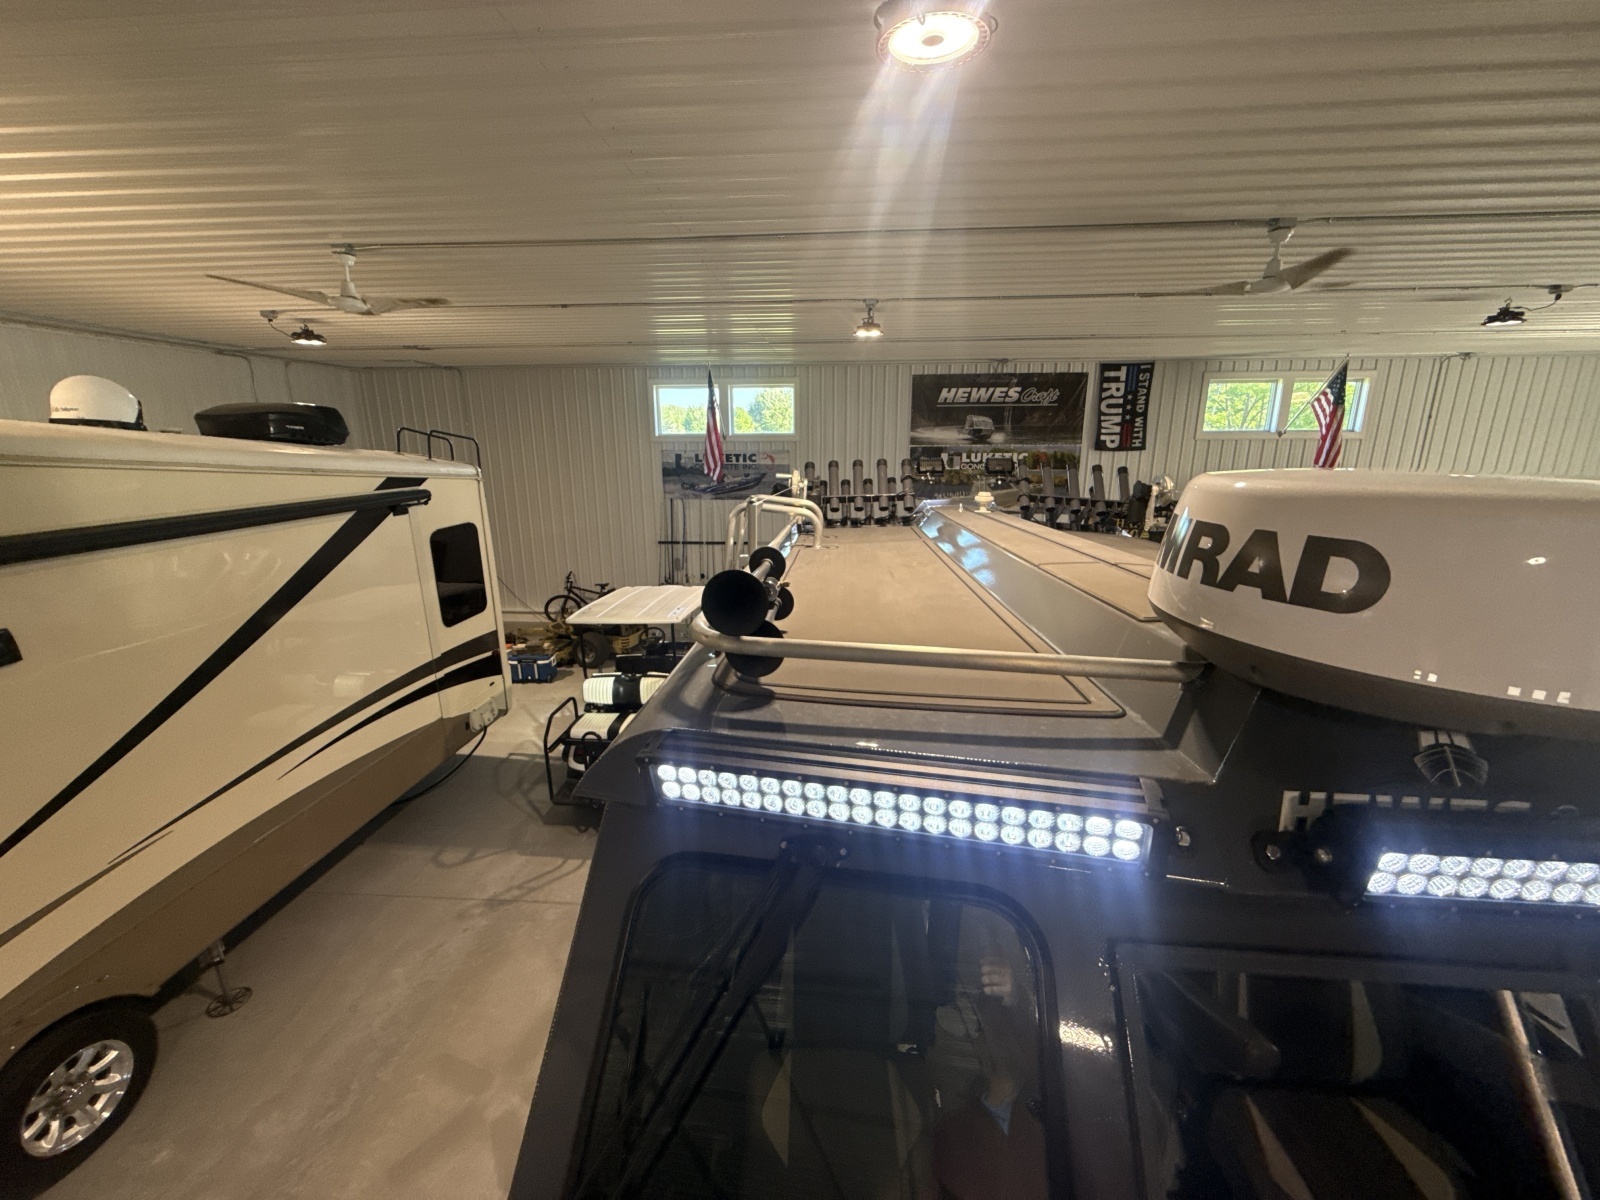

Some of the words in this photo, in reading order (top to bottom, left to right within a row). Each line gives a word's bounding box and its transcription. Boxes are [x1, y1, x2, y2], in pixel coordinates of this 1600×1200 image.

[937, 387, 1022, 403] HEWES
[1100, 365, 1128, 449] TRUMP
[1136, 372, 1151, 413] STAND
[1131, 416, 1144, 447] WITH
[694, 453, 757, 463] LETIC
[694, 463, 739, 471] COETE
[1157, 513, 1391, 614] MRAD
